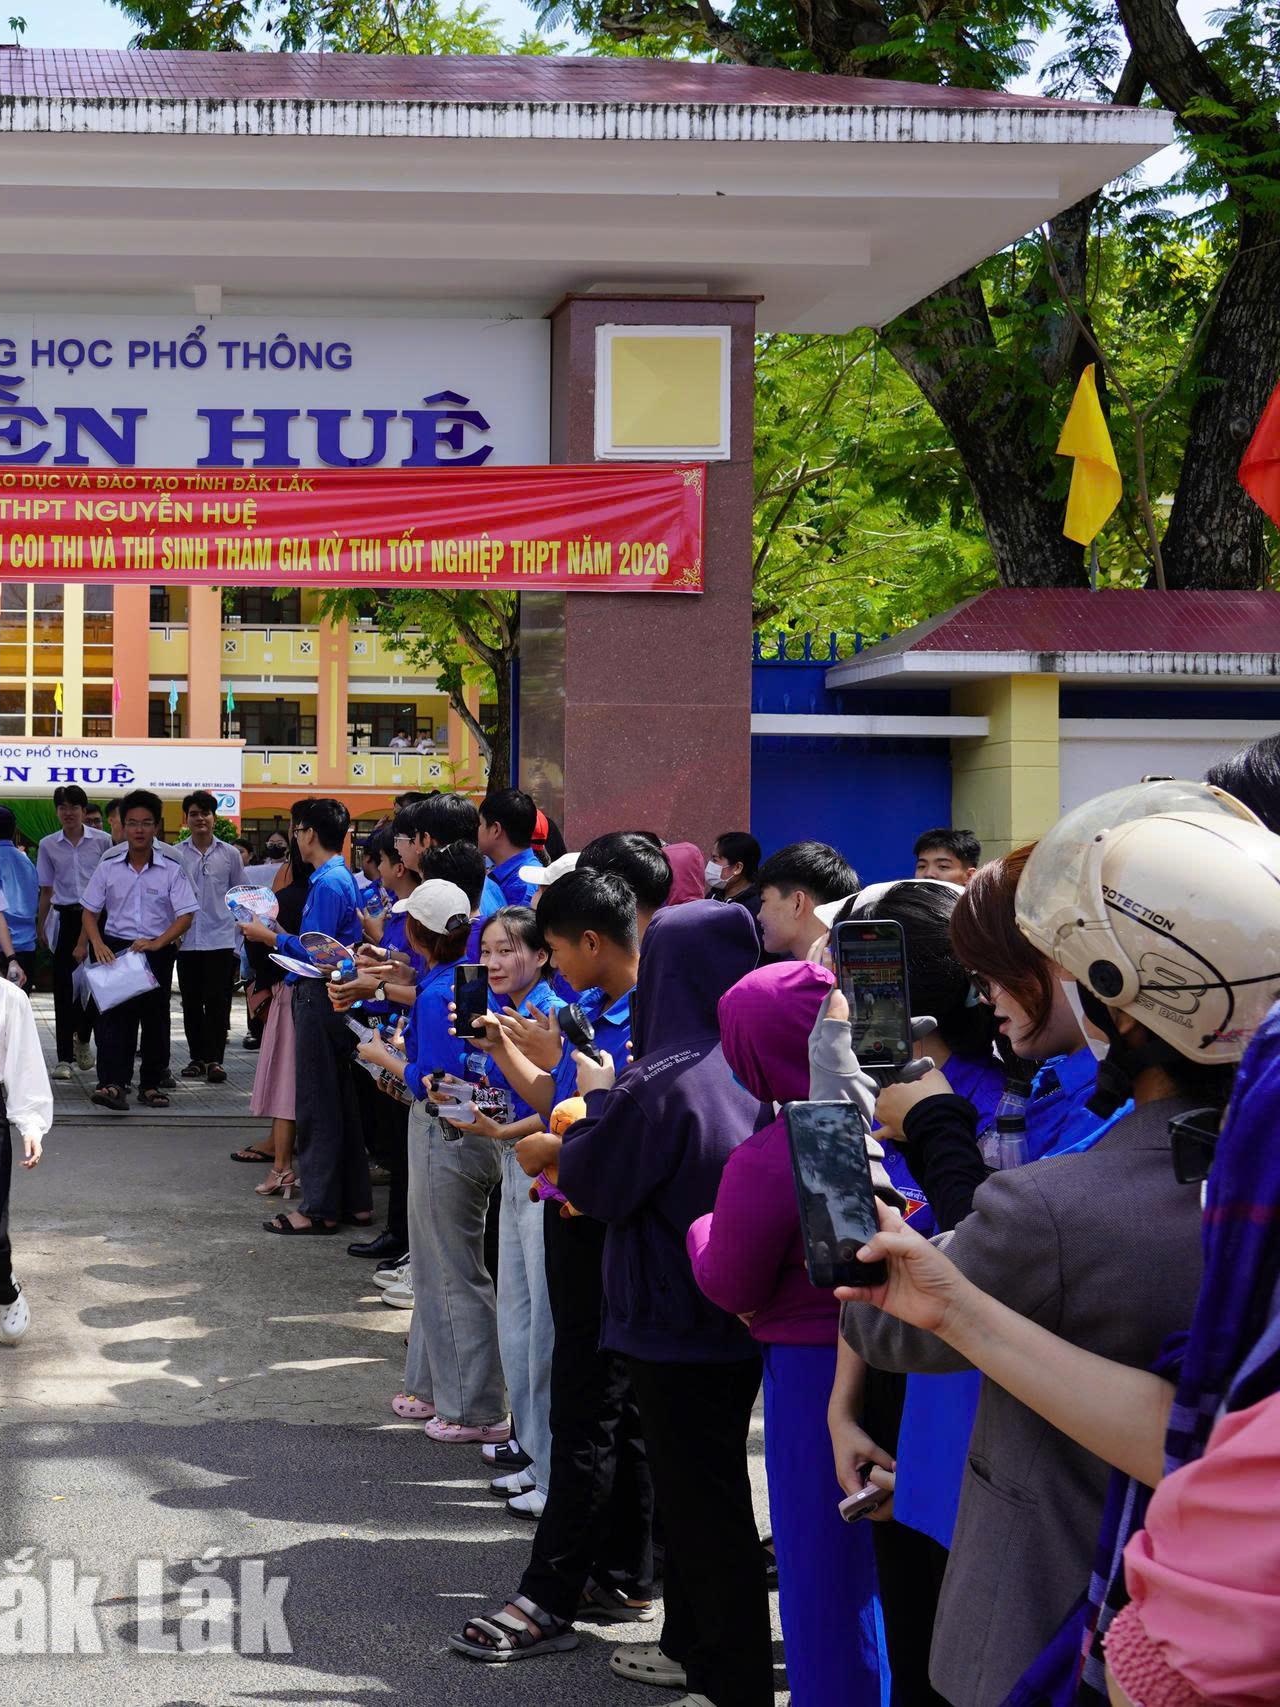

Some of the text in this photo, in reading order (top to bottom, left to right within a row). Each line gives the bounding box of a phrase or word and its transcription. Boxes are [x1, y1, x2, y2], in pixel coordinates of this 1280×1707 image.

[31, 339, 113, 375] HỌC
[128, 325, 208, 369] PHỔ
[218, 333, 353, 370] THÔNG
[22, 474, 61, 490] DỤC
[66, 472, 91, 489] VÀ
[97, 474, 136, 489] ĐÀO
[141, 476, 179, 492] TẠO
[184, 474, 227, 490] TỈNH
[75, 492, 193, 523] NGUYỄN
[202, 498, 257, 530] HUỆ
[10, 534, 44, 568] COI
[51, 535, 83, 568] THI
[90, 528, 116, 569] VÀ
[122, 528, 155, 569] THÍ
[161, 536, 208, 570] SINH
[215, 536, 271, 571] THAM
[279, 537, 312, 571] GIA
[318, 530, 344, 572] KỲ
[349, 538, 381, 572] THI
[387, 526, 425, 573] TỐT
[431, 532, 505, 582] NGHIỆP
[511, 540, 561, 574] THPT
[567, 534, 612, 575] NĂM
[619, 542, 669, 576] 2026
[26, 745, 51, 758] PHỔ
[57, 747, 99, 758] THÔNG
[47, 763, 136, 787] HUỆ
